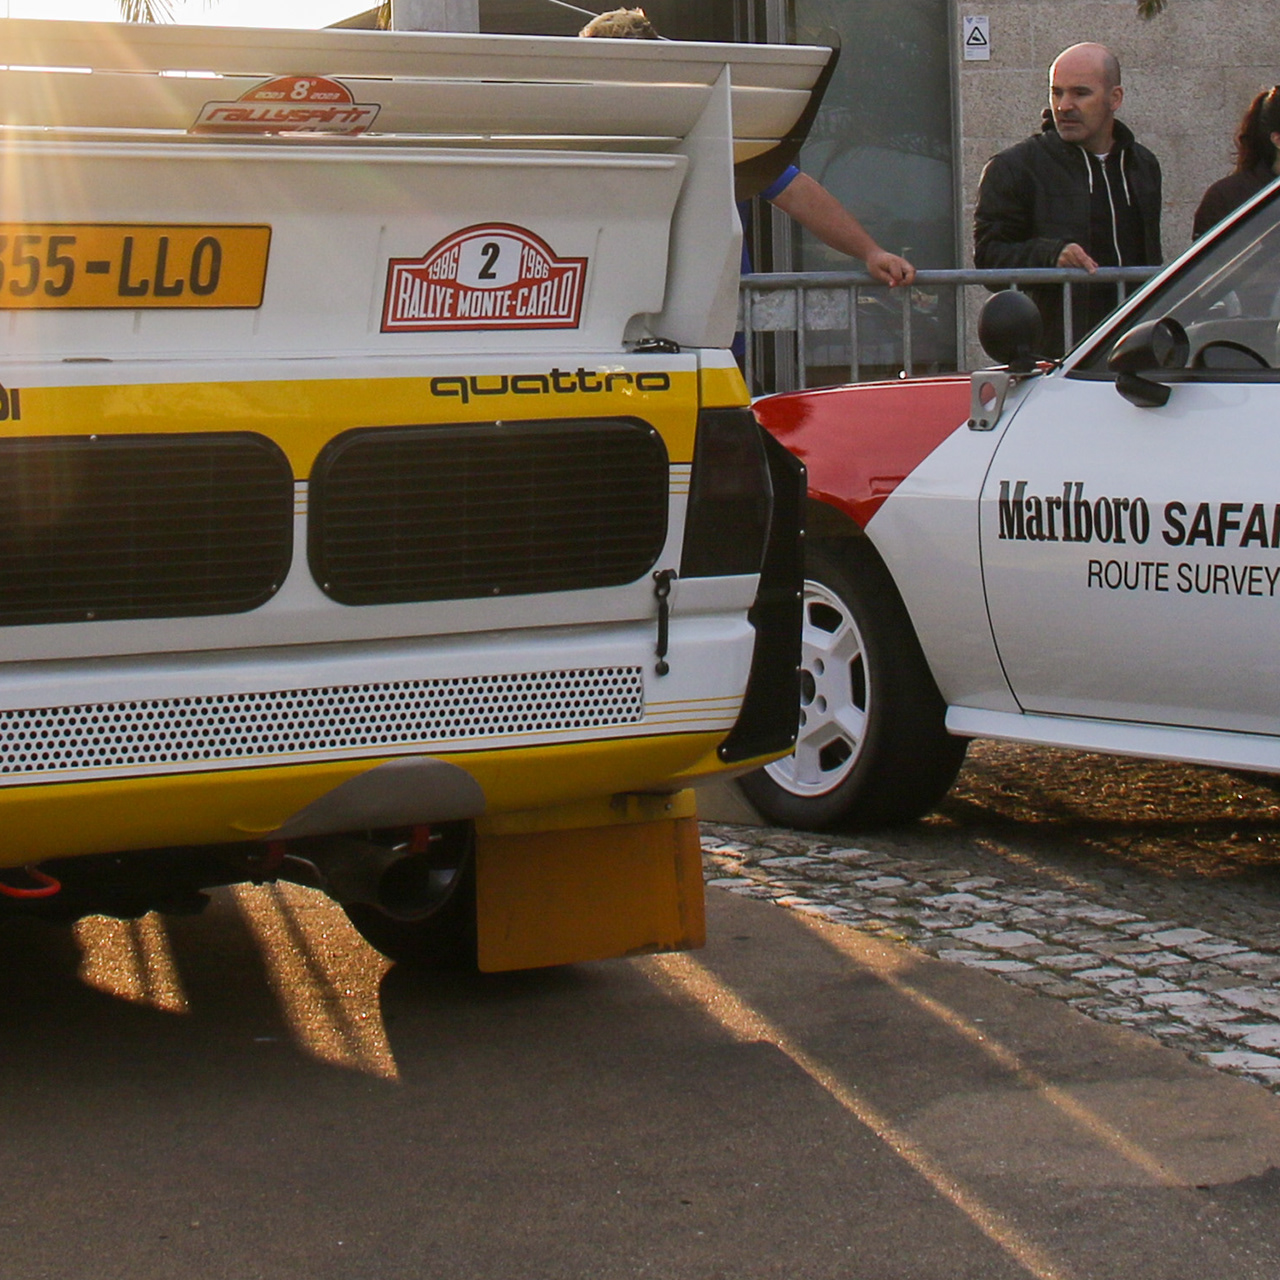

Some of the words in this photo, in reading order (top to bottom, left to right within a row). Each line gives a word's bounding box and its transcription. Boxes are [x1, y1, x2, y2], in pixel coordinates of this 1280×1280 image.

[427, 245, 459, 280] 1986
[477, 241, 501, 280] 2
[521, 245, 550, 279] 1986
[396, 270, 455, 319] RALLYE
[456, 270, 574, 318] MONTE-CARLO
[429, 367, 671, 405] quattro
[998, 479, 1151, 546] Marlboro
[1086, 559, 1170, 592] ROUTE
